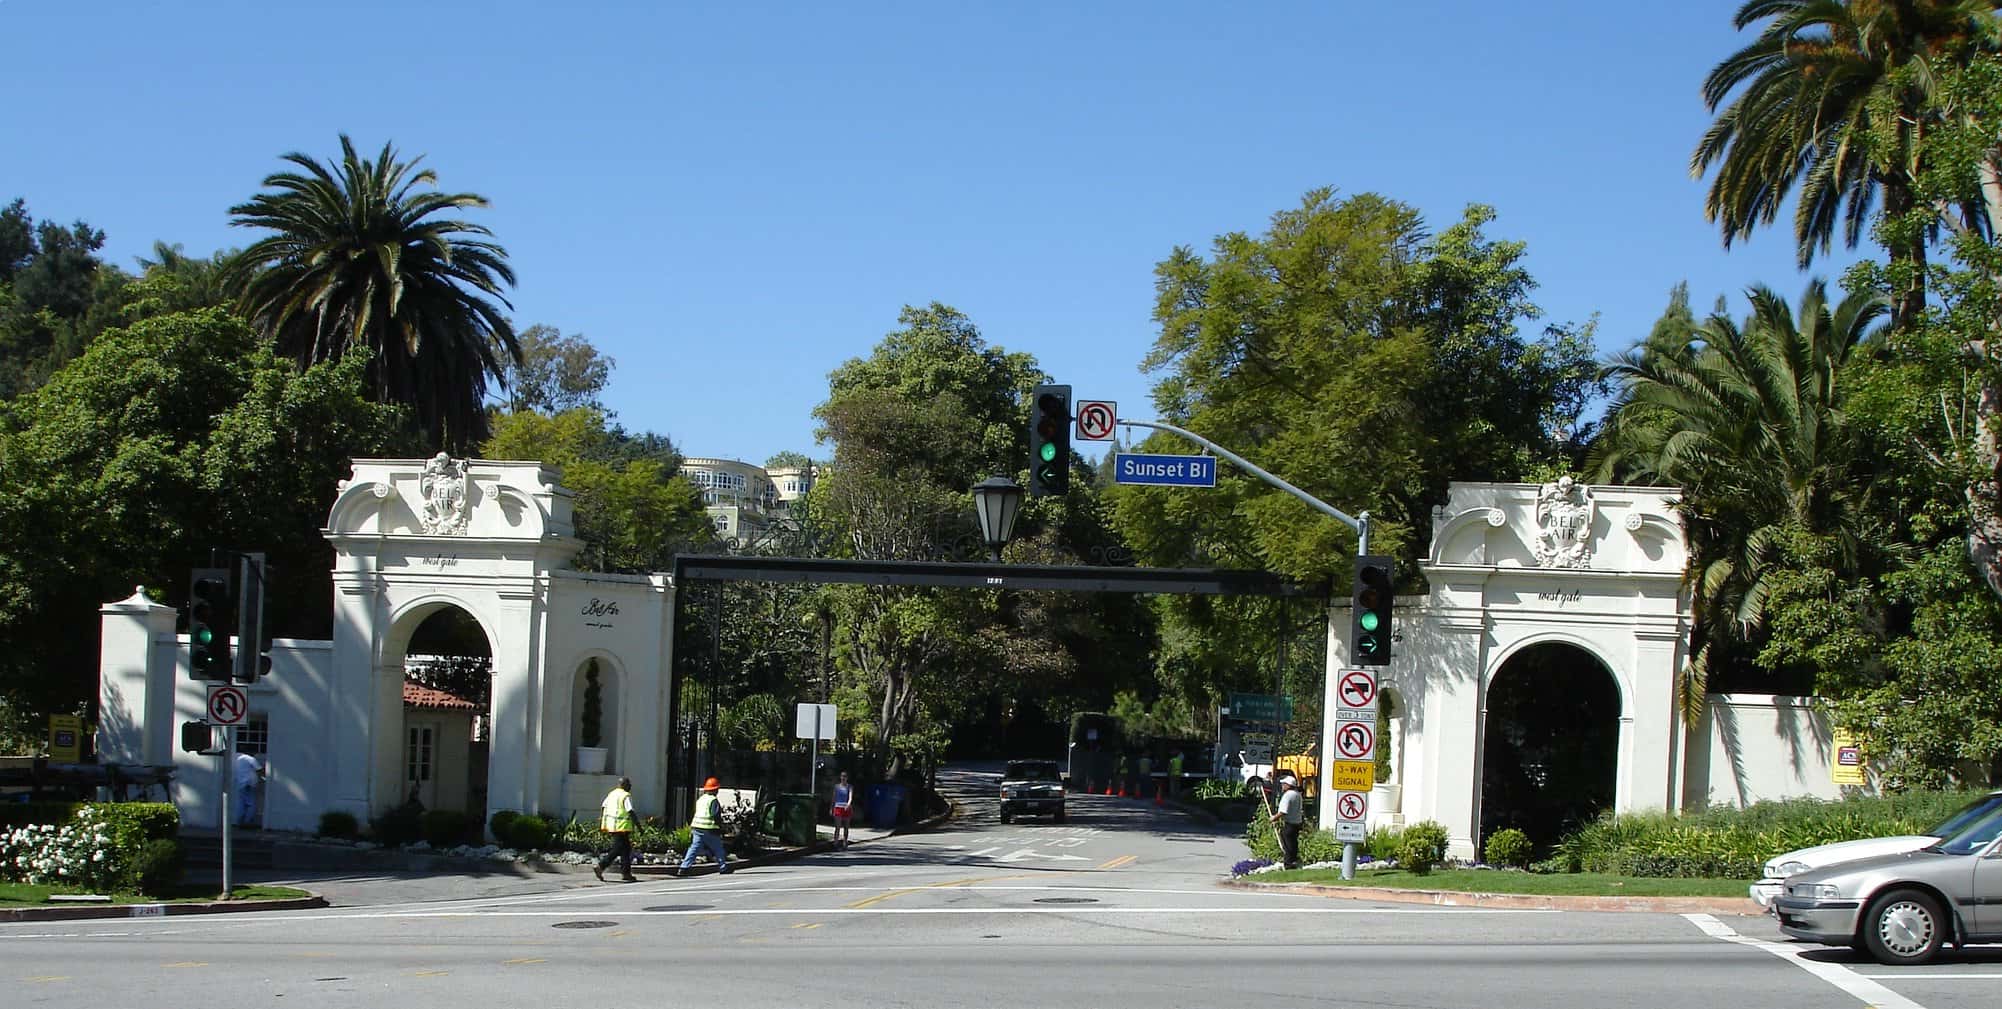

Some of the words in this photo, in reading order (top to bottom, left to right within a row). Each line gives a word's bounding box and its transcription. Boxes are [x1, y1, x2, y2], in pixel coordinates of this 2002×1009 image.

[1124, 460, 1184, 477] Sunset
[1190, 462, 1207, 478] Bl
[432, 487, 454, 499] BEL
[432, 499, 454, 510] AIR
[1550, 515, 1577, 528] BEL
[1551, 528, 1575, 540] AIR
[1537, 588, 1560, 601] west
[1559, 589, 1581, 608] gate
[1338, 765, 1368, 774] 3-WAY
[1337, 777, 1368, 787] SIGNAL
